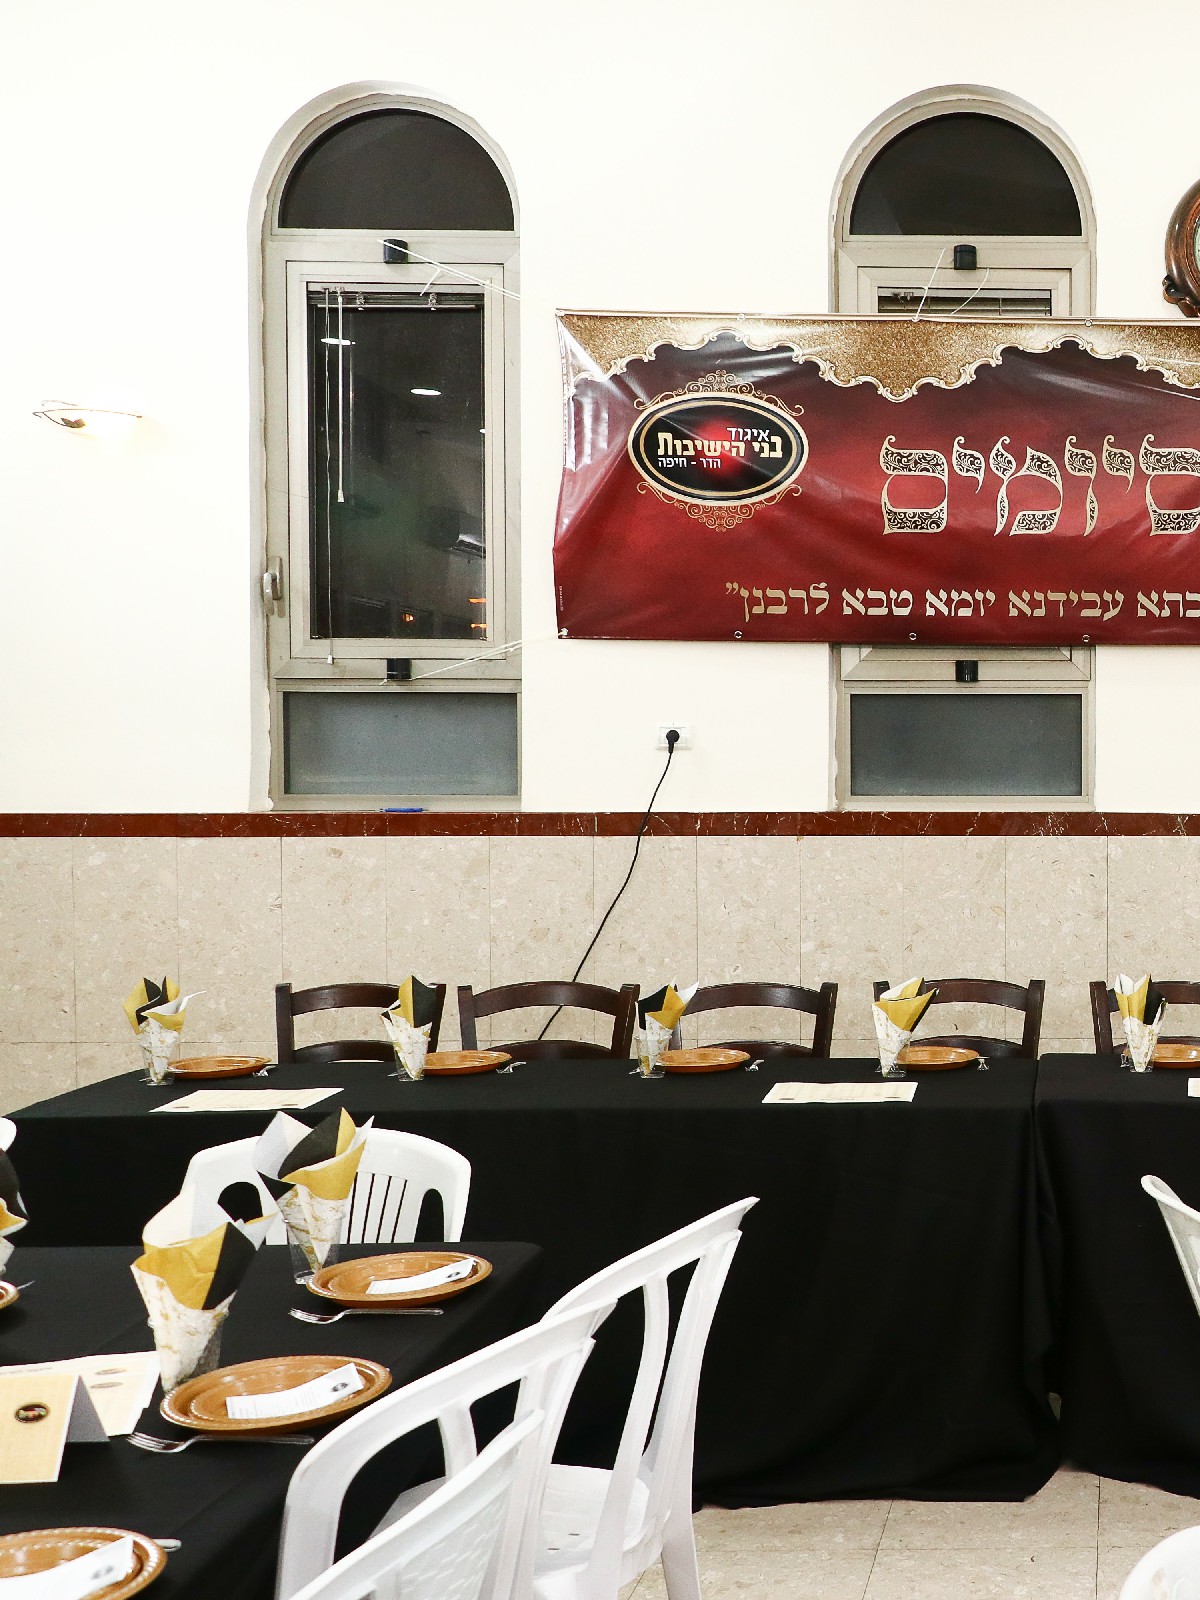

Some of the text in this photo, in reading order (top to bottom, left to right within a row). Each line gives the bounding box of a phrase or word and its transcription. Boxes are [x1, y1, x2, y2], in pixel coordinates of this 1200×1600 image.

[657, 432, 783, 458] בני הישיבות
[727, 427, 770, 442] איגוד
[658, 457, 687, 468] חיפה
[700, 457, 721, 469] הדר
[841, 587, 914, 616] טבא
[925, 588, 996, 617] יומא
[1008, 589, 1125, 622] עבידנא
